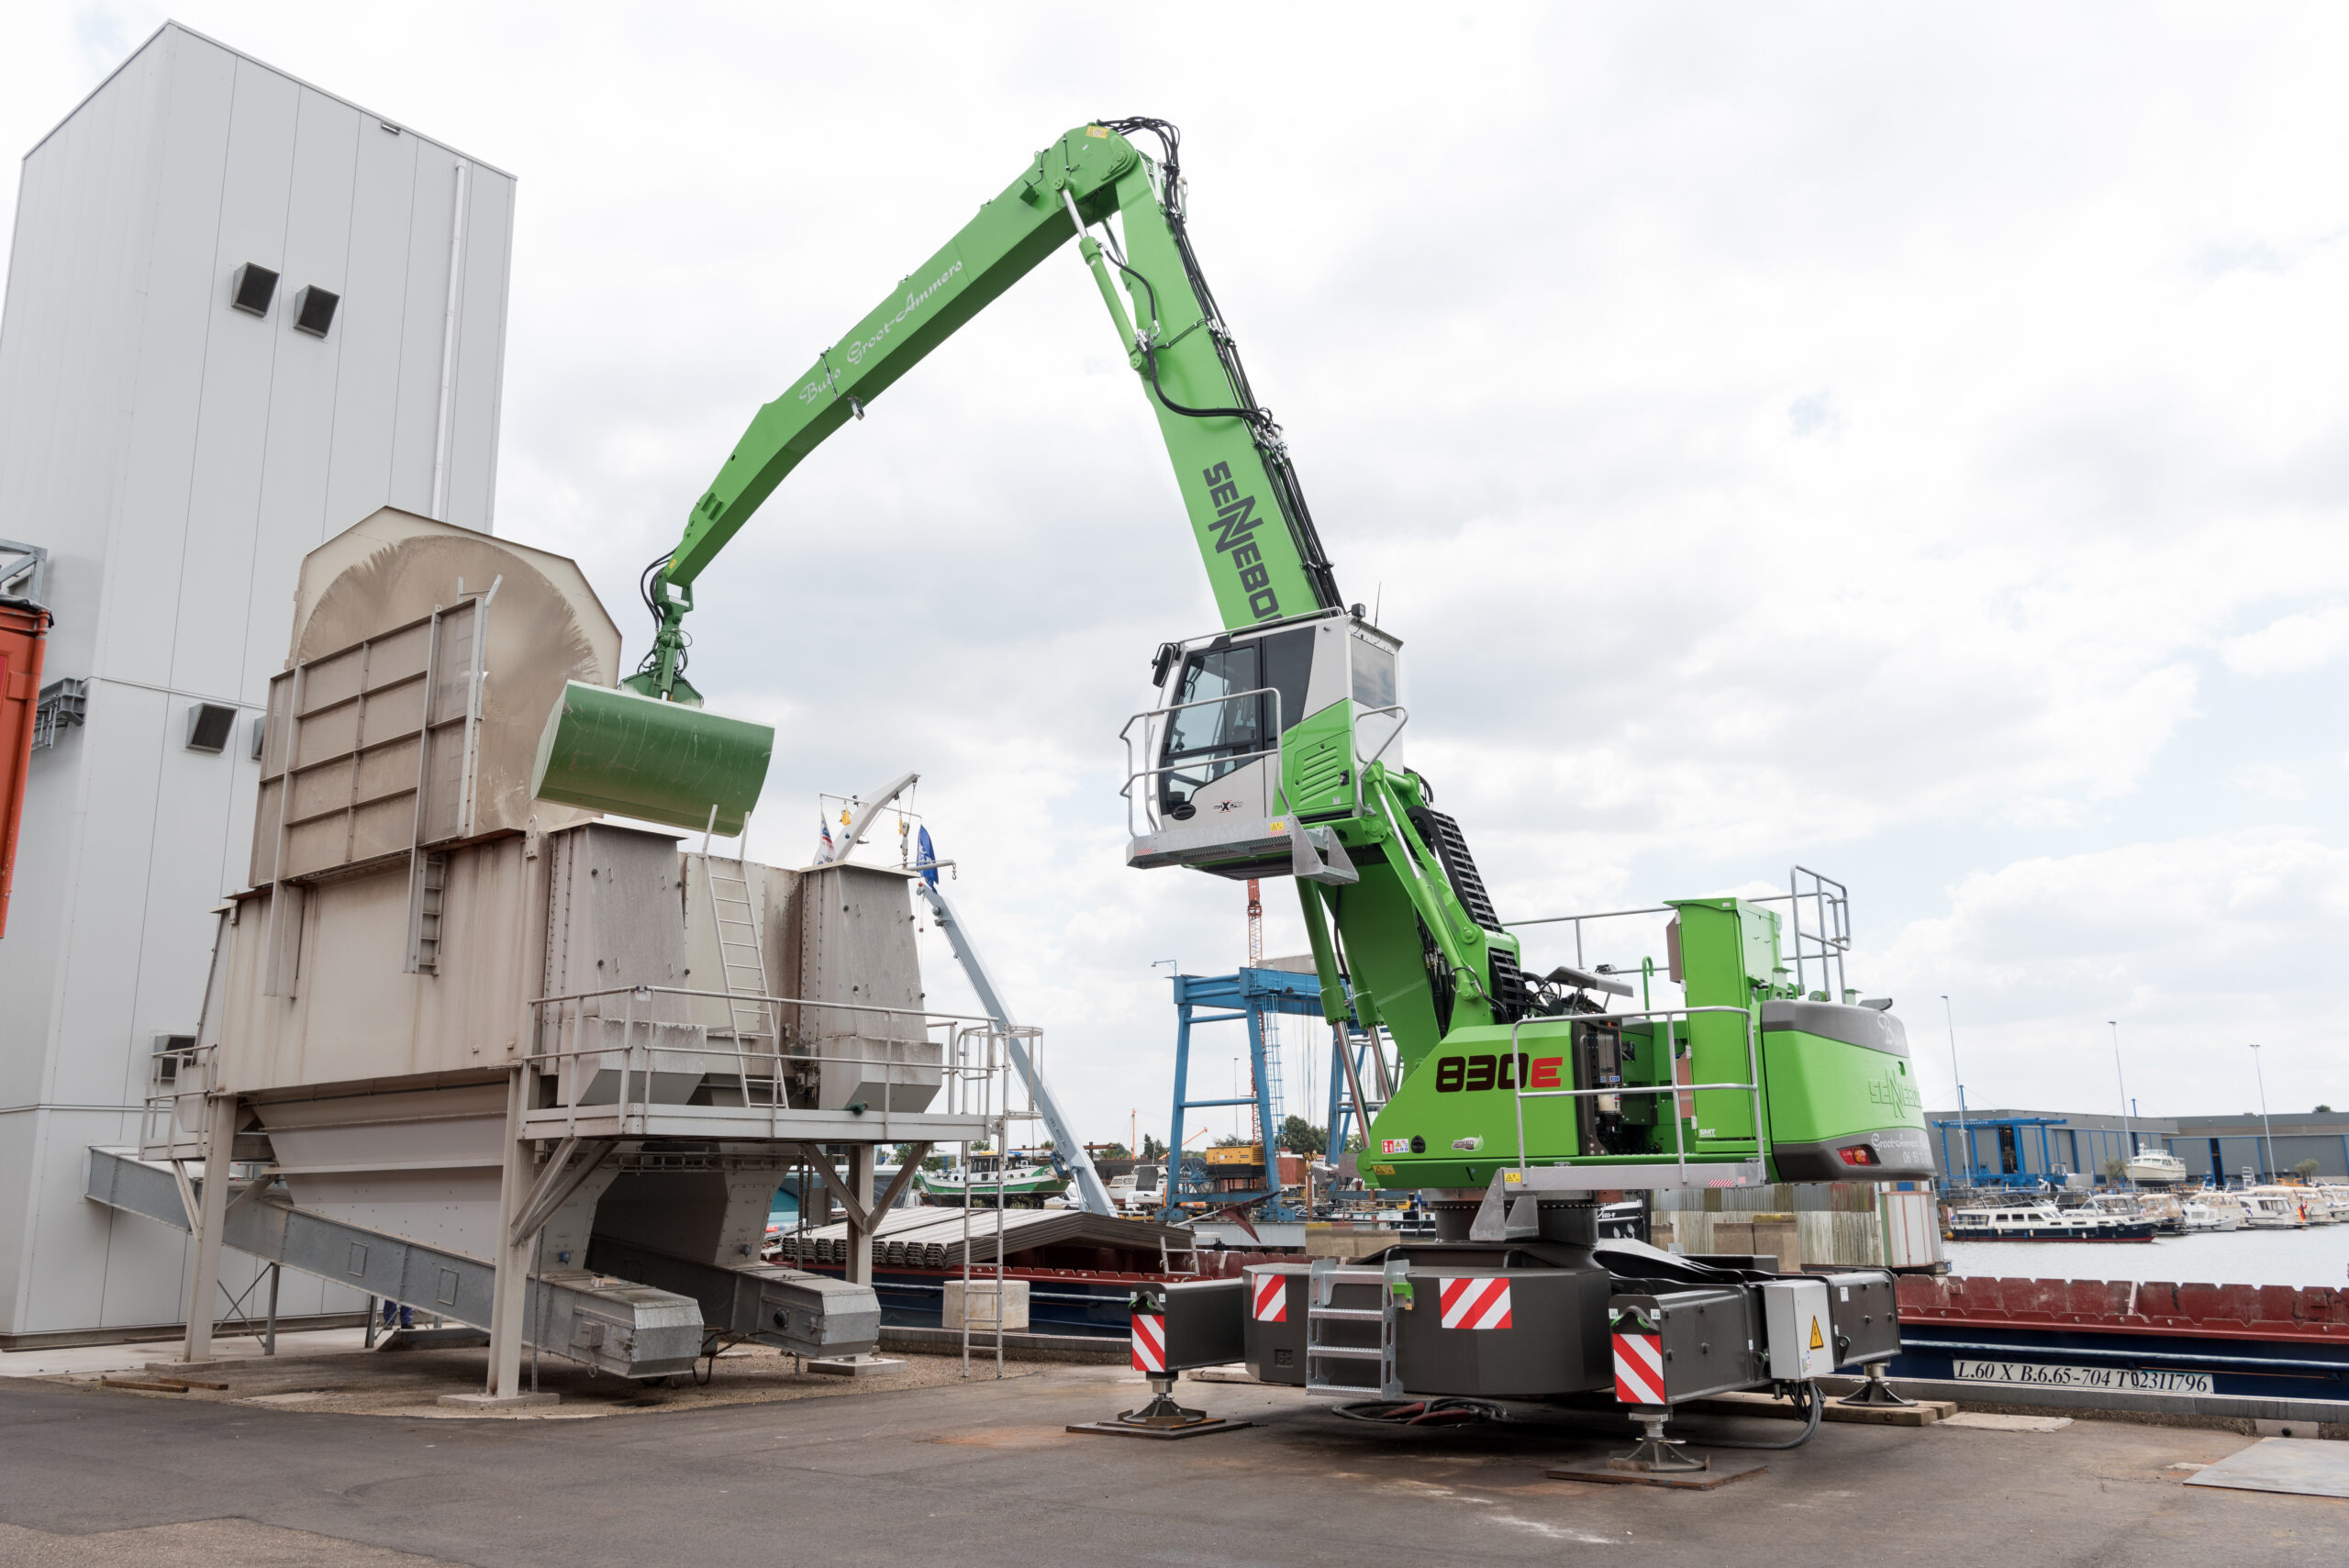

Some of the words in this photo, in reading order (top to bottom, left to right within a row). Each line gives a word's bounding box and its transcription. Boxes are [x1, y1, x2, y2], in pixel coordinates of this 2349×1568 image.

[847, 260, 963, 364] Groot-Ammers
[1203, 461, 1284, 623] SENNEBO
[1436, 1053, 1564, 1093] 830E
[1958, 1362, 1995, 1379] L.60
[2000, 1364, 2013, 1380] X
